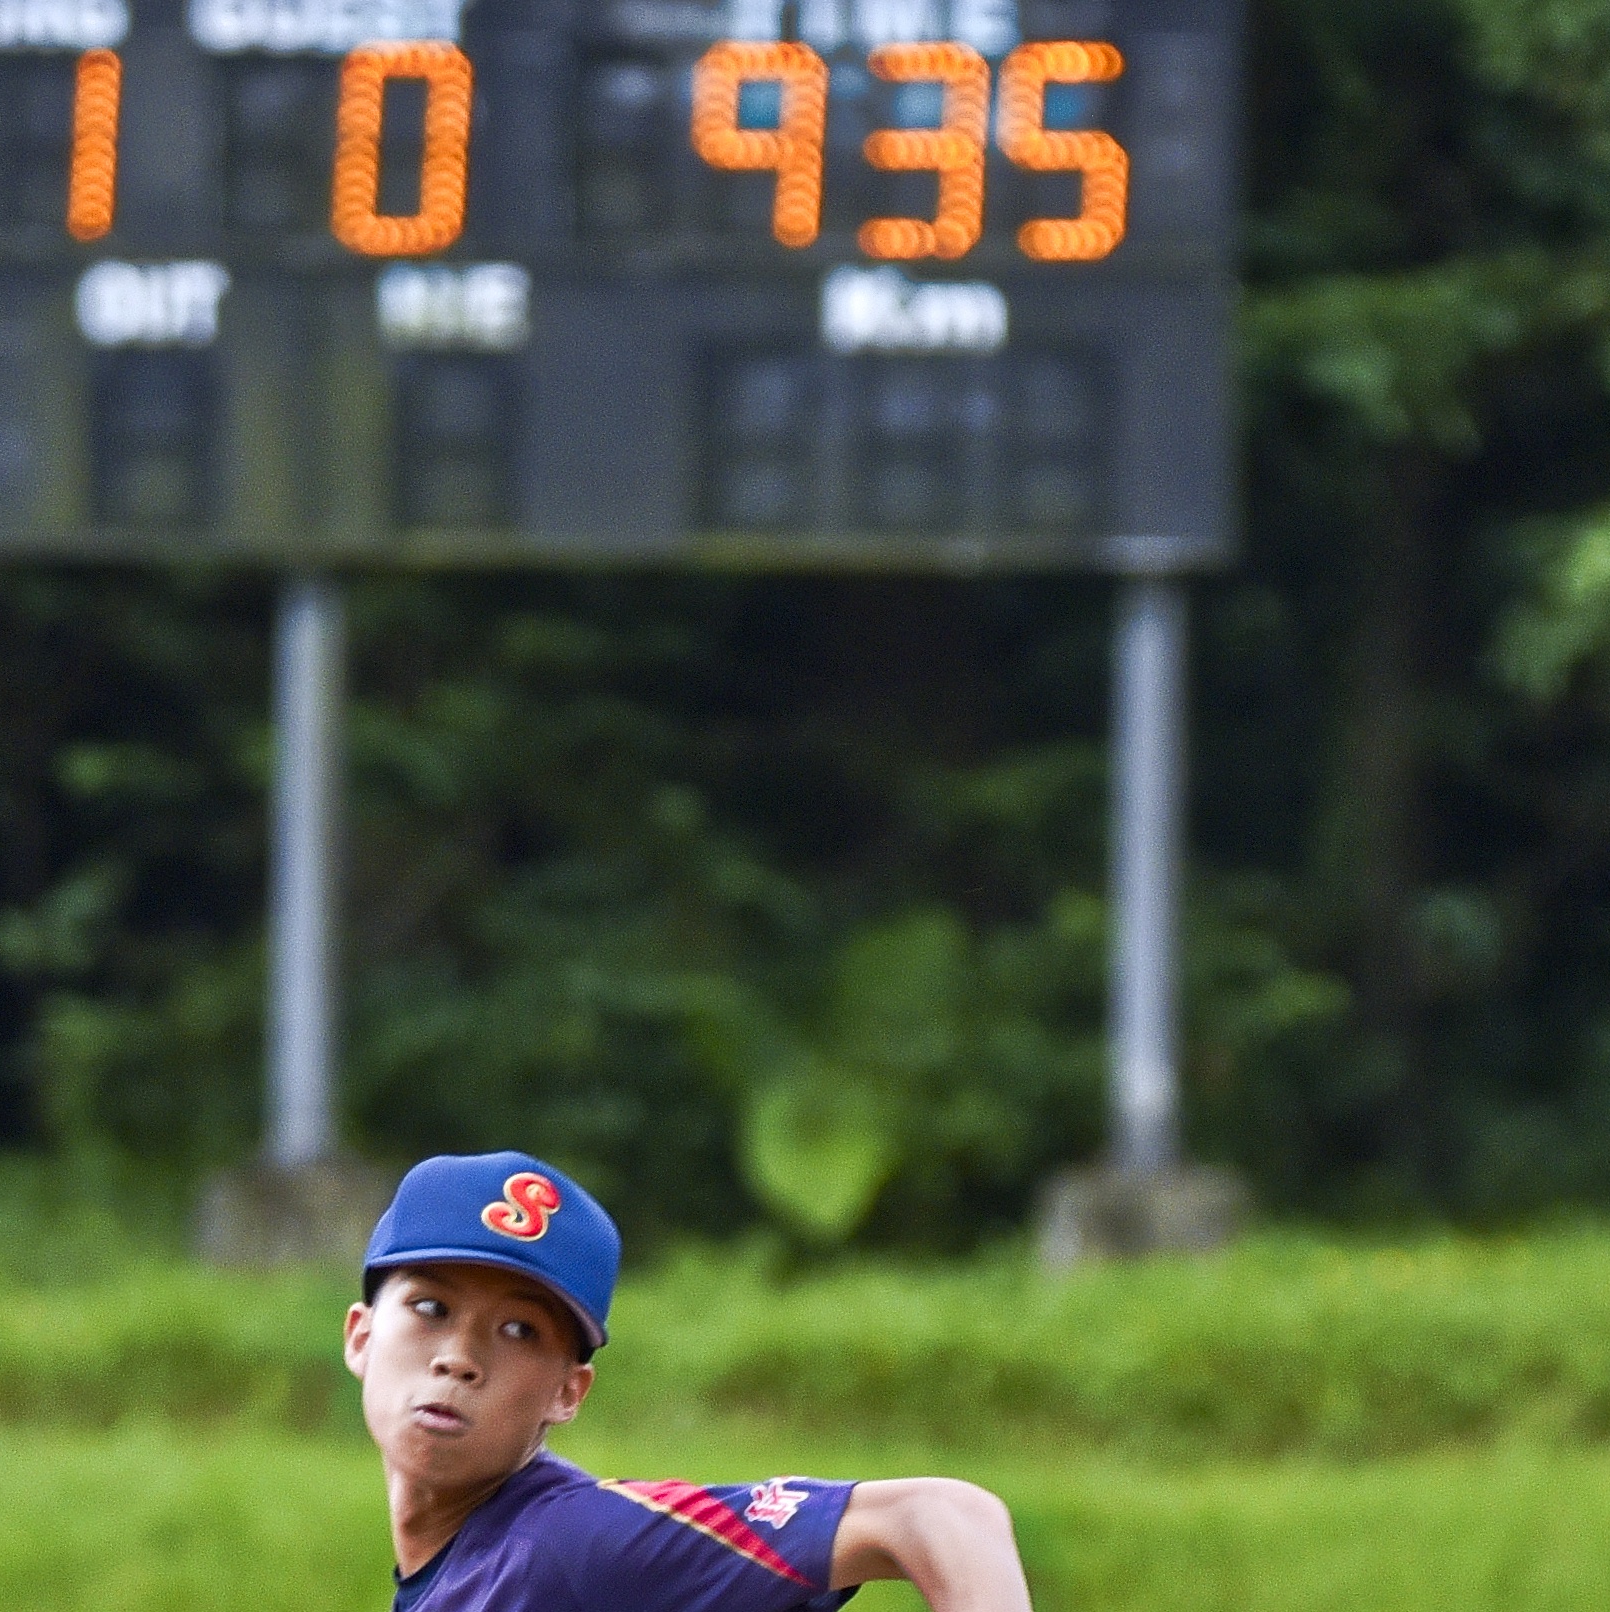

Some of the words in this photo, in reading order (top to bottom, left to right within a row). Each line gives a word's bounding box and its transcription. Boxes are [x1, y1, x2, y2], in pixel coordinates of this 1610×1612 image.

[67, 48, 122, 240] 1
[331, 41, 473, 257] 0
[481, 1171, 561, 1242] S
